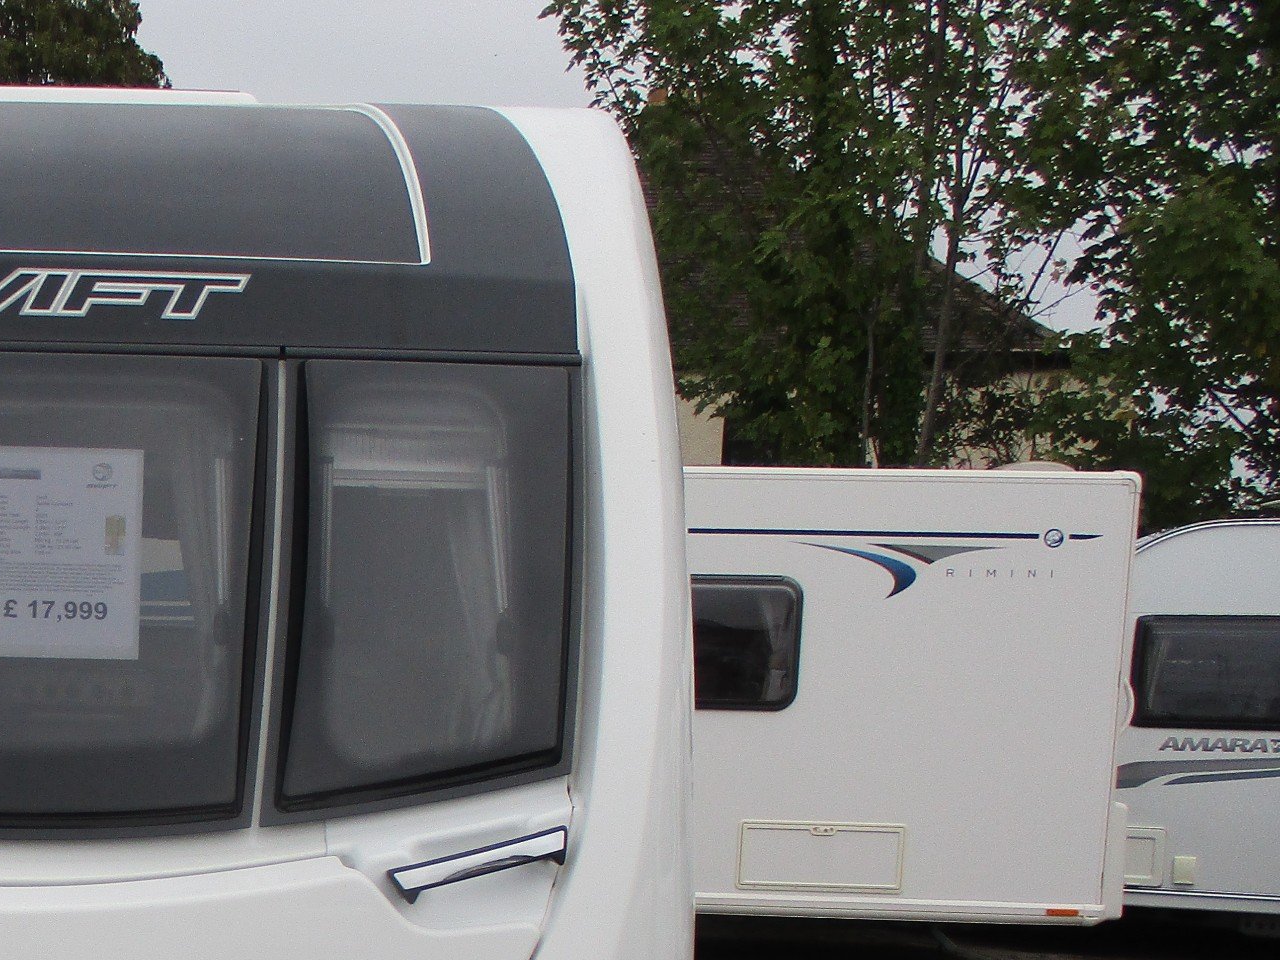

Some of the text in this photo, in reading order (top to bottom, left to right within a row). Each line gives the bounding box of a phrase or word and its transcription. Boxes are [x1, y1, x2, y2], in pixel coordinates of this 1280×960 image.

[946, 568, 1054, 579] RIMINI
[3, 599, 108, 622] £ 17,999
